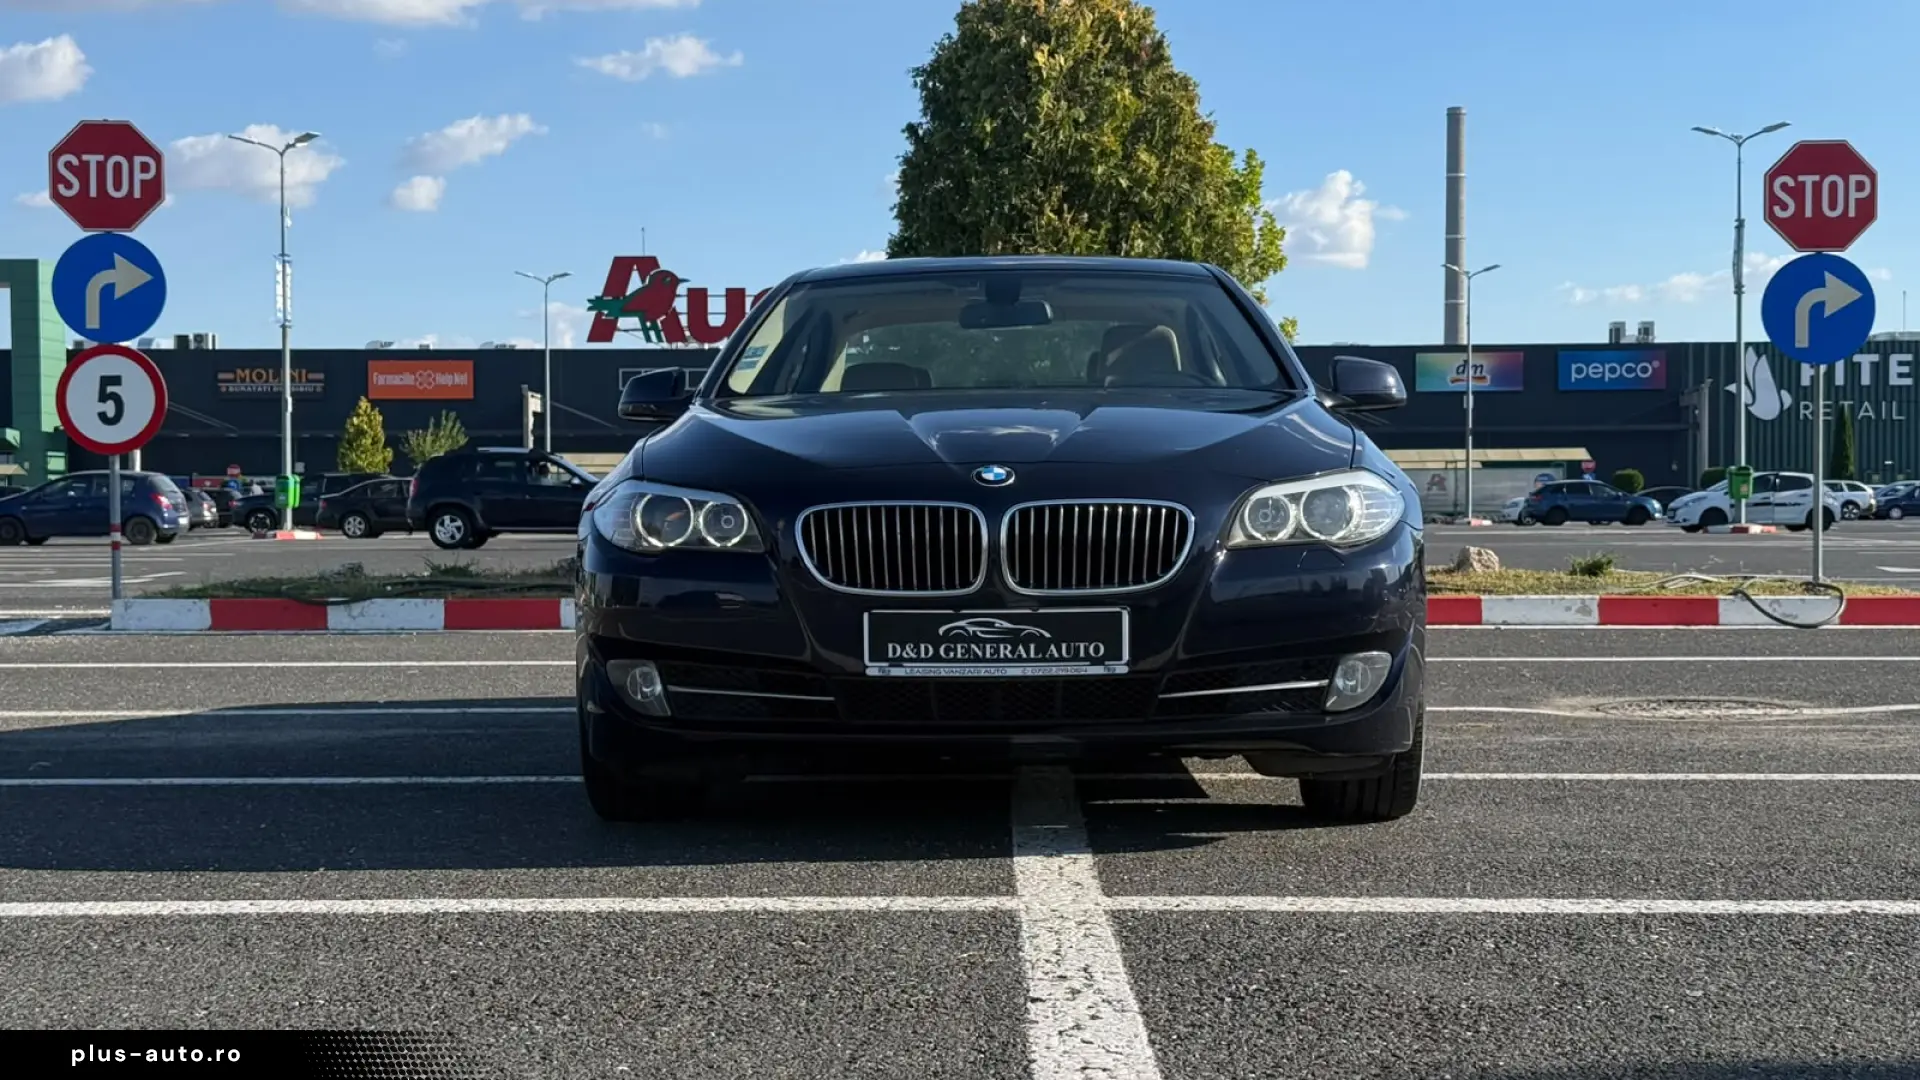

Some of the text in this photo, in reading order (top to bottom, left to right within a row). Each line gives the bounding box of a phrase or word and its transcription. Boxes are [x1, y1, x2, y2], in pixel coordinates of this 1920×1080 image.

[57, 154, 157, 199] STOP
[1772, 174, 1872, 219] STOP
[1571, 361, 1654, 382] pepco
[96, 374, 126, 426] 5
[887, 641, 1105, 659] D&D GENERAL AUTO
[983, 667, 1008, 675] AUTO
